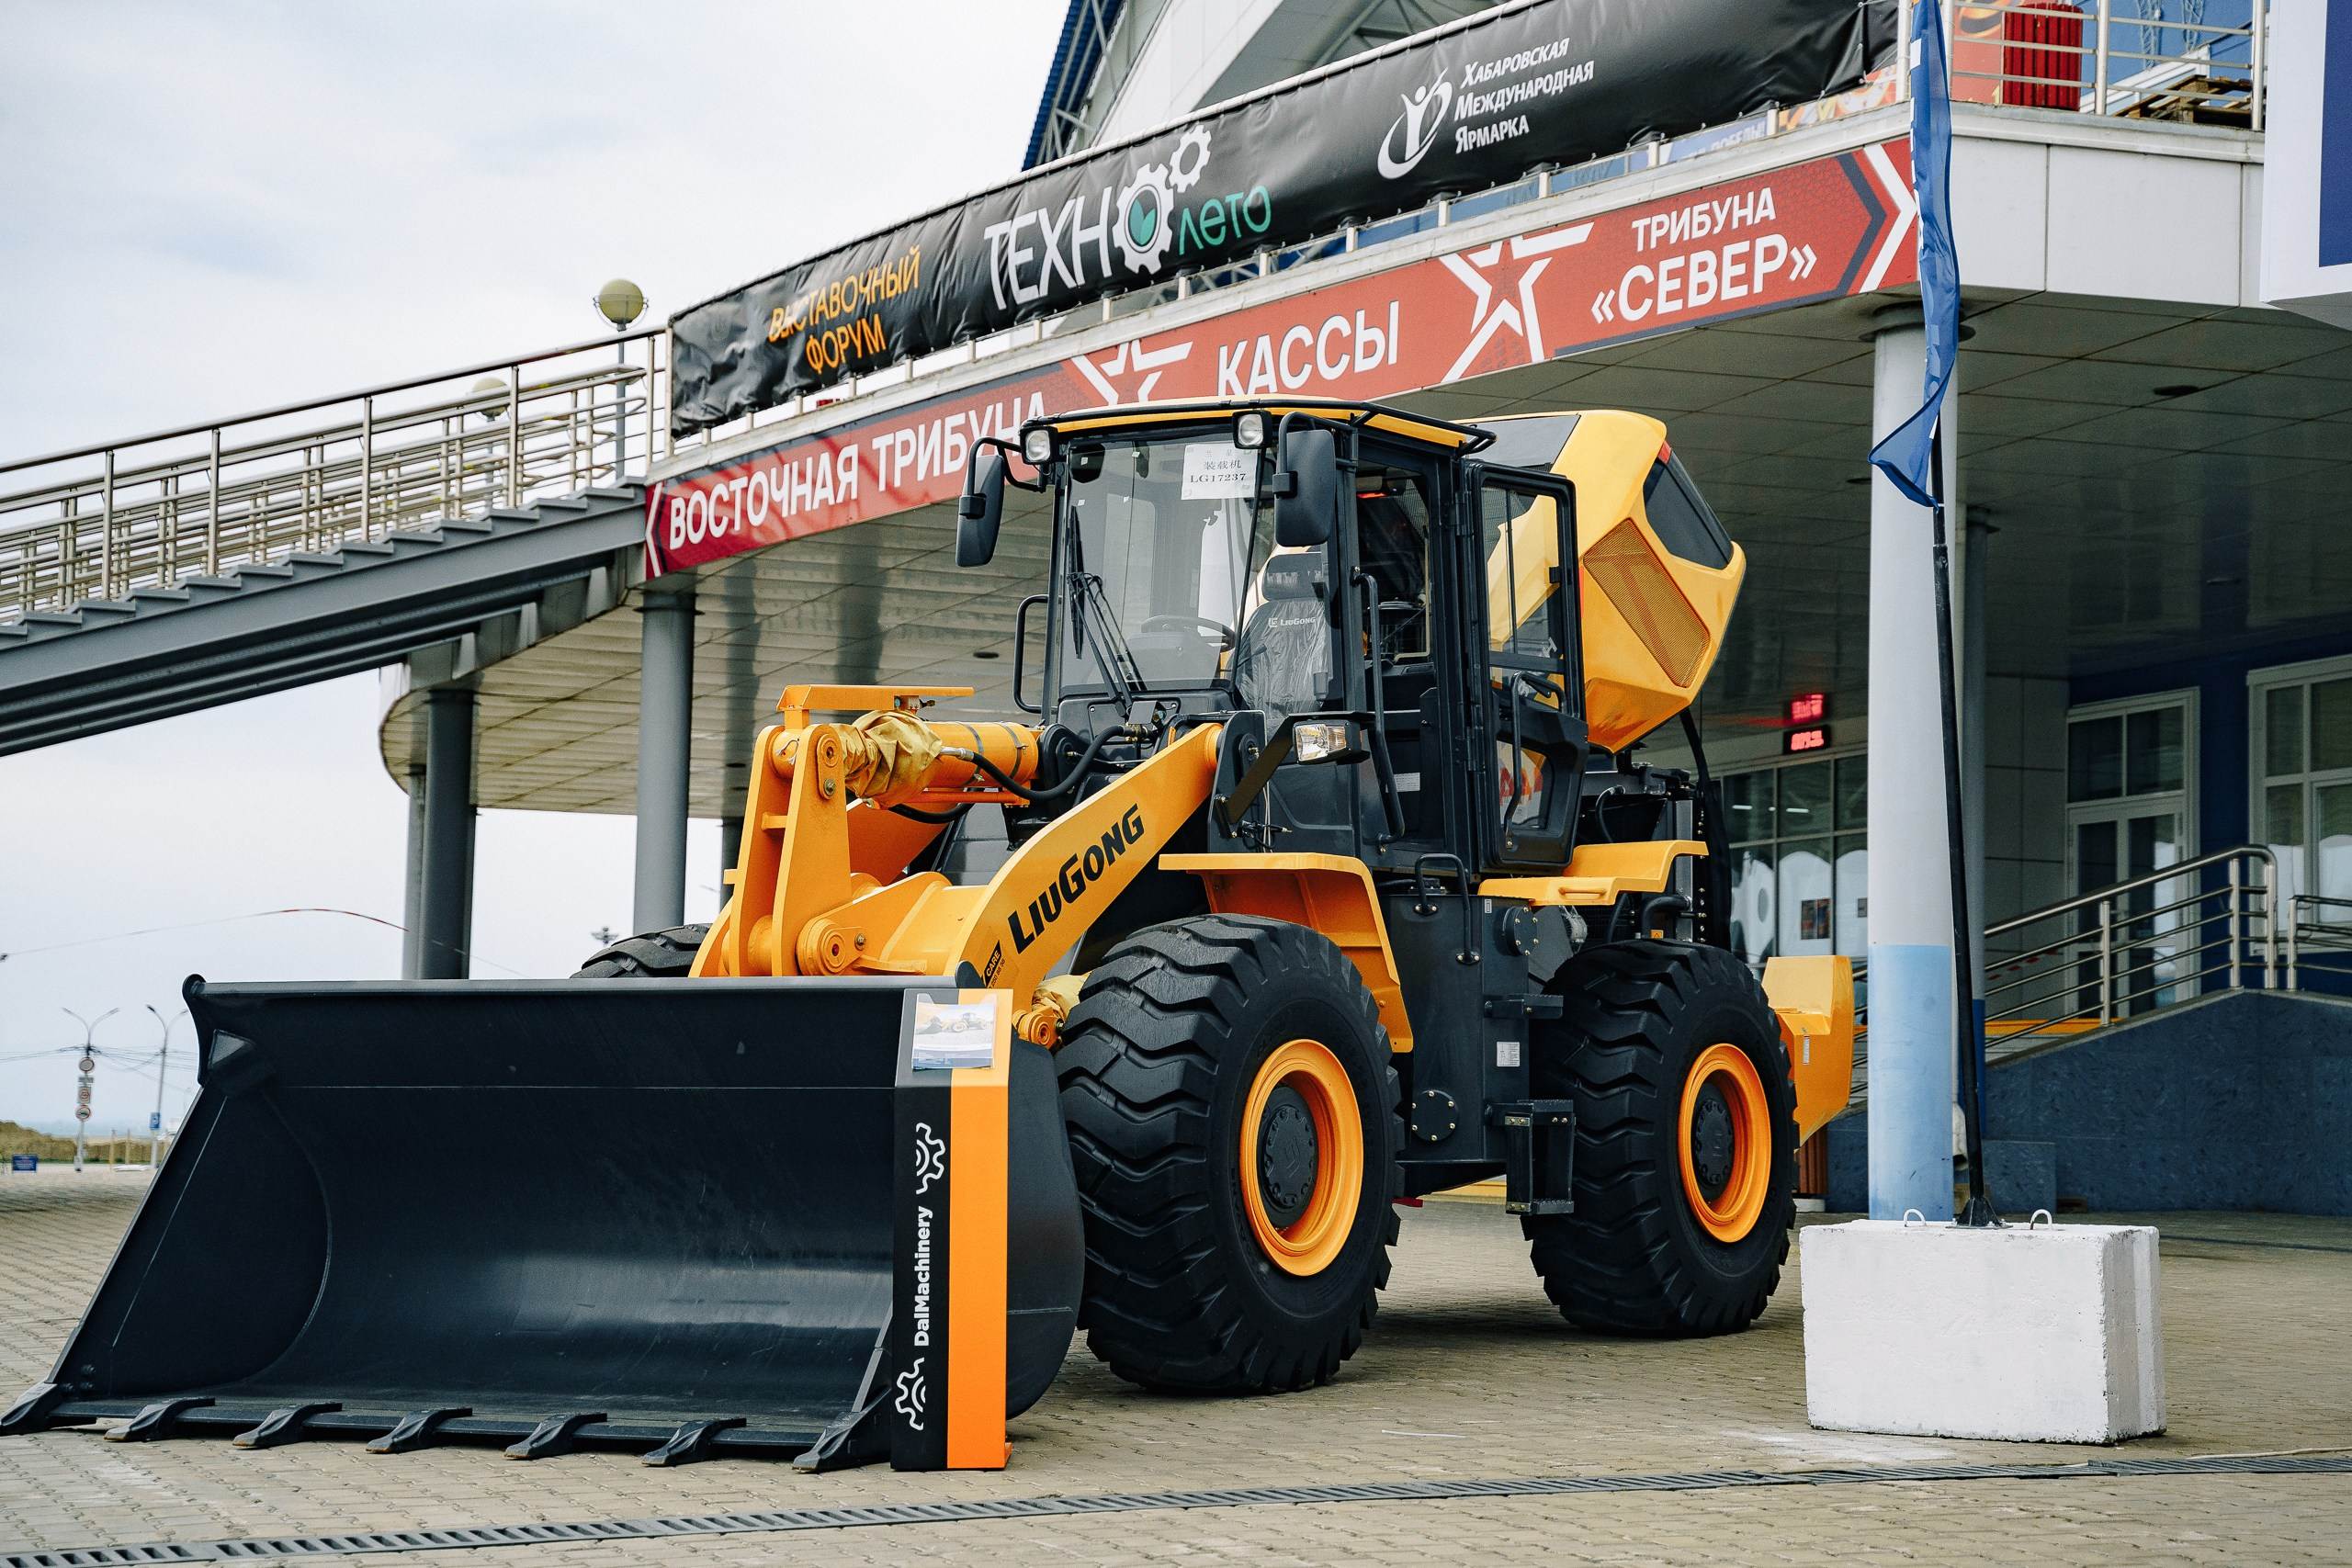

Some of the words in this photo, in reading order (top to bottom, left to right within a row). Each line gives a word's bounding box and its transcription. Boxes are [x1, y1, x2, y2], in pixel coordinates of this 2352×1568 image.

[1453, 60, 1595, 122] МЕЖДУНАРОДНАЯ
[1460, 37, 1570, 89] ХАБАРОВСКАЯ
[1454, 114, 1530, 154] ЯРМАРКА
[1631, 186, 1777, 253] ТРИБУНА
[768, 243, 921, 343] ВЫСТАВОЧНЫЙ
[1590, 233, 1818, 324] «СЕВЕР»
[805, 313, 887, 375] ФОРУМ
[1217, 300, 1399, 397] КАССЫ
[1190, 473, 1247, 483] LG17237
[1204, 459, 1242, 470] 装载机
[669, 443, 859, 551] ВОСТОЧНАЯ
[986, 950, 1001, 977] CARE
[913, 1205, 933, 1347] DalMachinery
